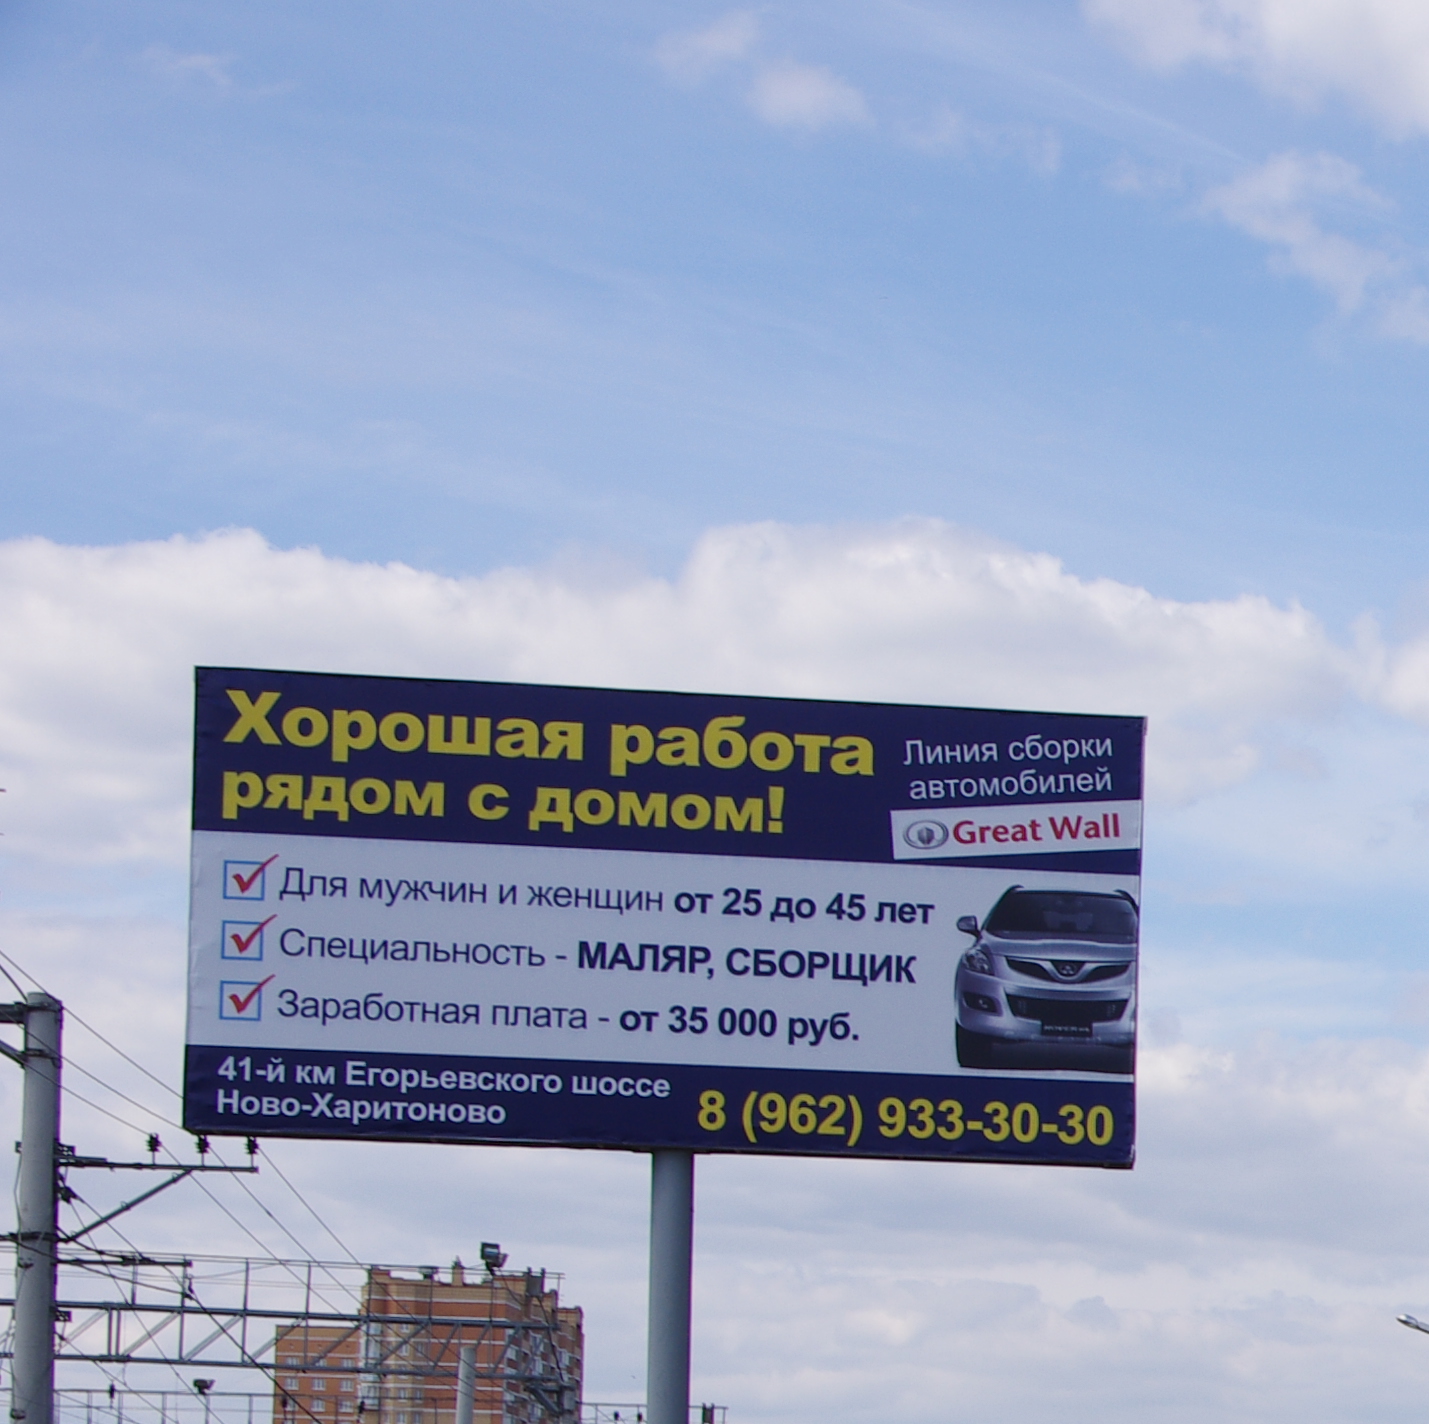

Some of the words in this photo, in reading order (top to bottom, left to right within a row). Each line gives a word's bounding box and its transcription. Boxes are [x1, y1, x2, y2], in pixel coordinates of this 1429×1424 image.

[222, 689, 584, 763] Хорошая
[610, 715, 875, 777] работа
[903, 739, 998, 766] Линия
[1008, 734, 1113, 764] сборки
[222, 771, 445, 822] рядом
[468, 783, 510, 821] с
[528, 786, 785, 834] домом!
[909, 766, 1112, 800] автомобилей
[953, 819, 1043, 845] Great
[1048, 813, 1120, 840] Wall
[279, 867, 347, 901] Для
[359, 877, 487, 907] мужчин
[499, 884, 517, 905] и
[527, 885, 663, 915] женщин
[674, 892, 713, 913] от
[722, 887, 762, 917] 25
[770, 897, 817, 923] до
[825, 892, 866, 921] 45
[874, 901, 935, 924] лет
[279, 928, 546, 966] Специальность
[578, 940, 714, 980] МАЛЯР,
[725, 948, 917, 987] СБОРЩИК
[277, 989, 480, 1026] Заработная
[491, 1004, 588, 1029] плата
[619, 1009, 659, 1032] от
[668, 1005, 708, 1035] 35
[717, 1007, 777, 1037] 000
[787, 1012, 859, 1046] руб.
[218, 1055, 285, 1083] 41-й
[295, 1063, 335, 1085] км
[345, 1060, 562, 1094] Егорьевского
[572, 1075, 671, 1098] шоссе
[217, 1088, 506, 1124] Ново-Харитоново
[698, 1090, 726, 1130] 8
[742, 1090, 863, 1147] (962)
[877, 1097, 1114, 1146] 933-30-30
